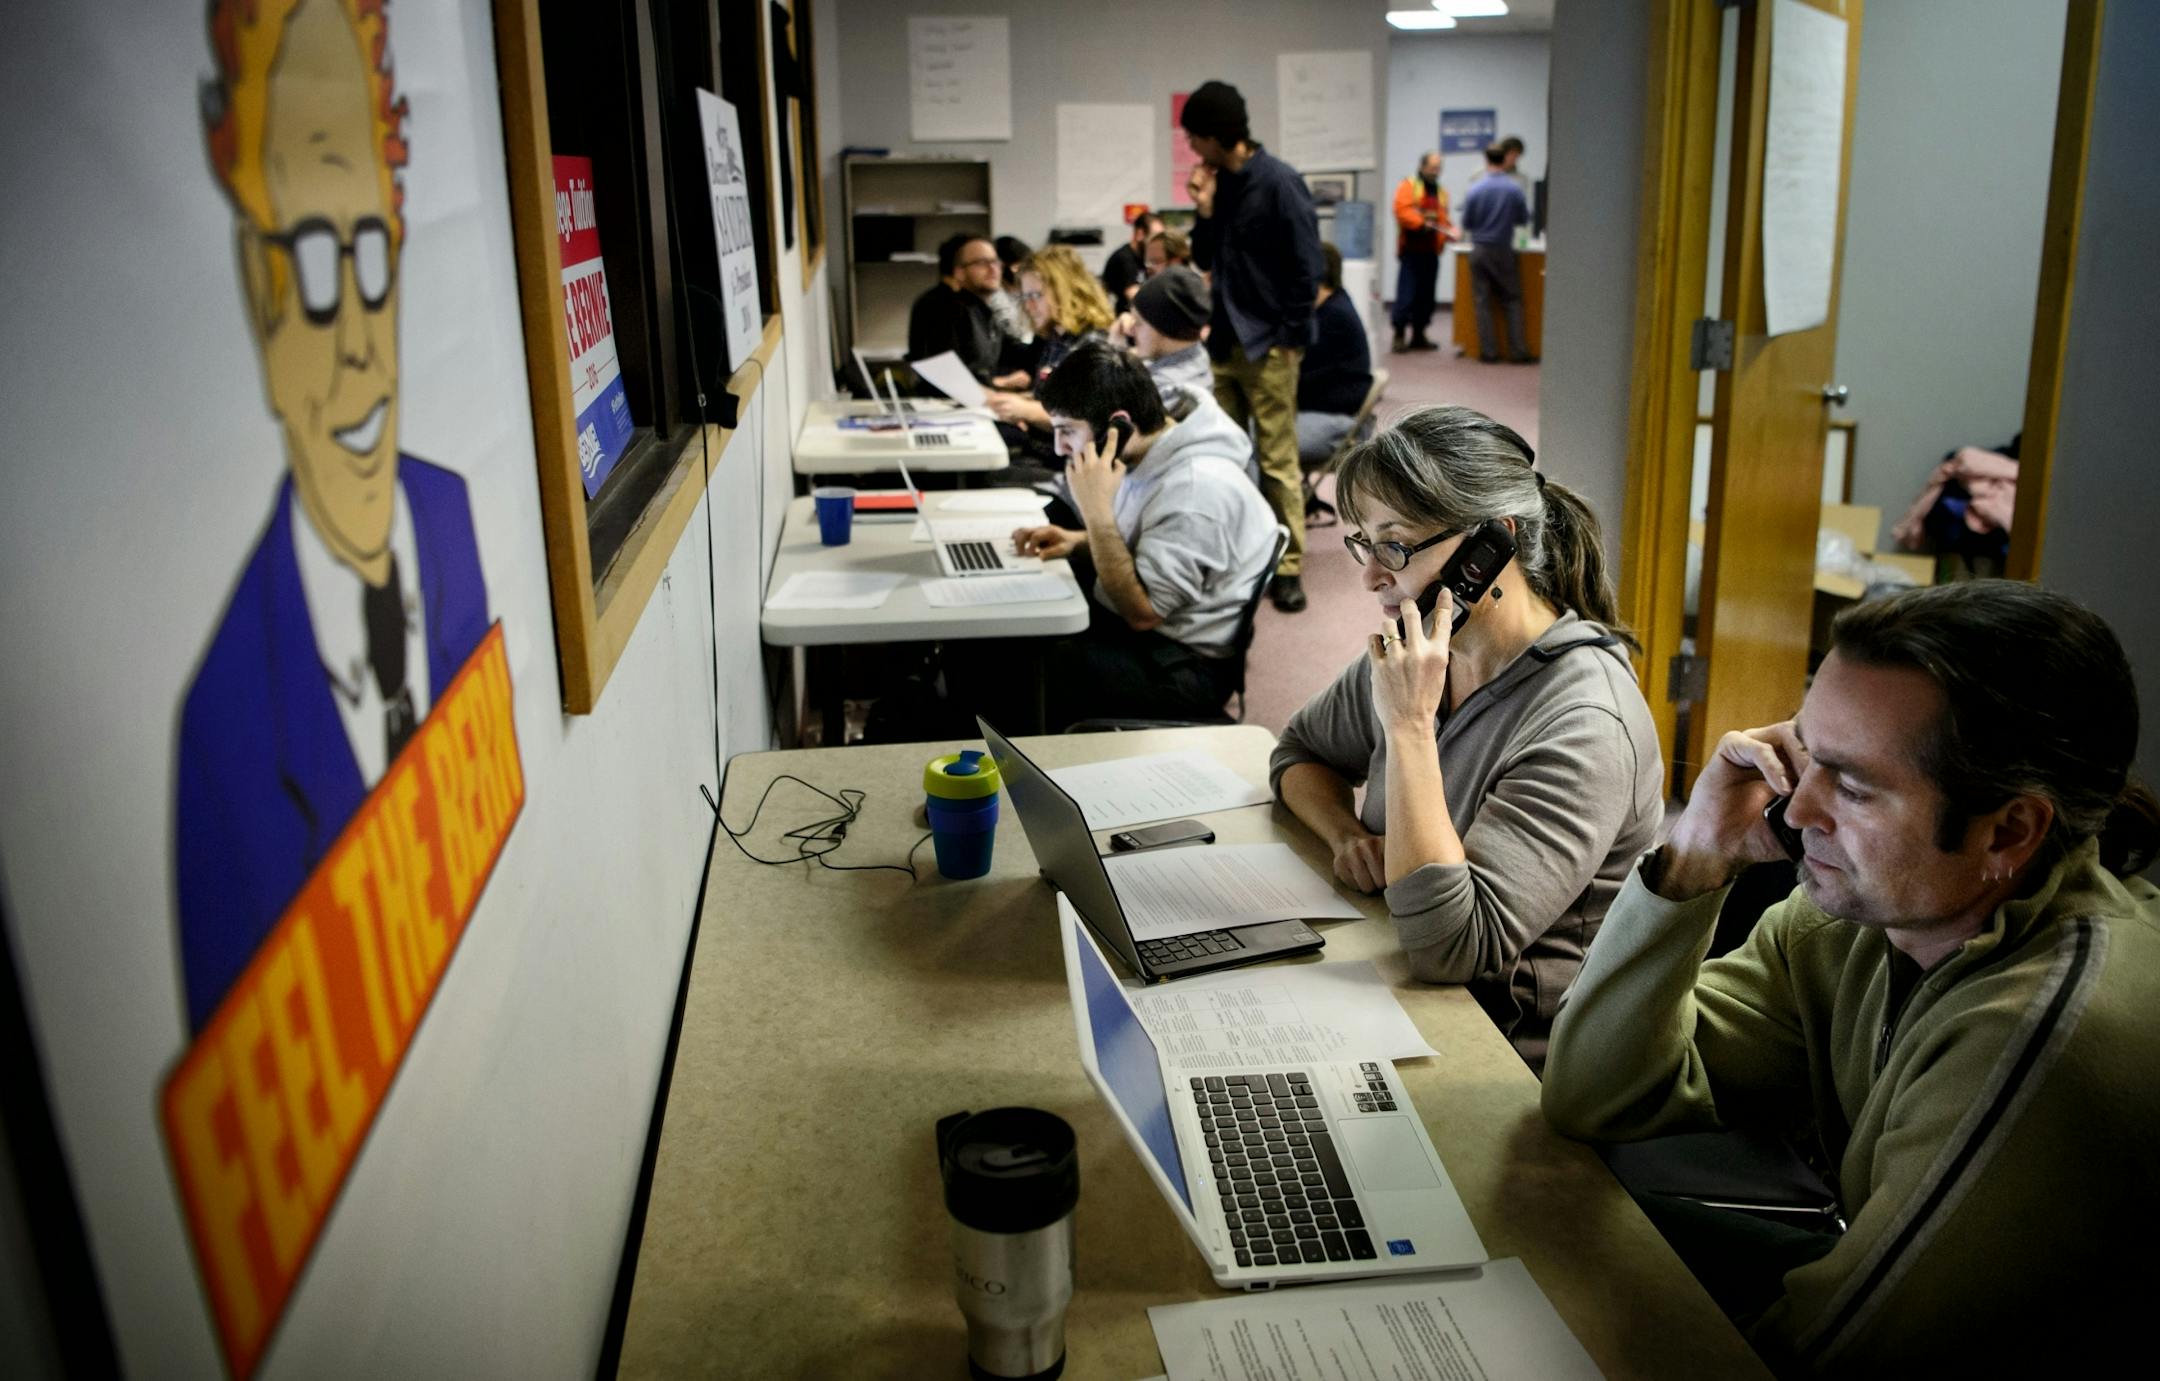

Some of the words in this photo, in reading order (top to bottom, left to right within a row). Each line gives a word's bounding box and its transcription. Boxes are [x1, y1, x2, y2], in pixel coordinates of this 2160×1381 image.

[553, 178, 574, 243] lege
[569, 178, 597, 231] Tuition
[569, 271, 611, 353] BERNIE
[174, 912, 368, 1356] FEEL
[332, 761, 447, 1068] THE
[424, 637, 523, 918] BERN
